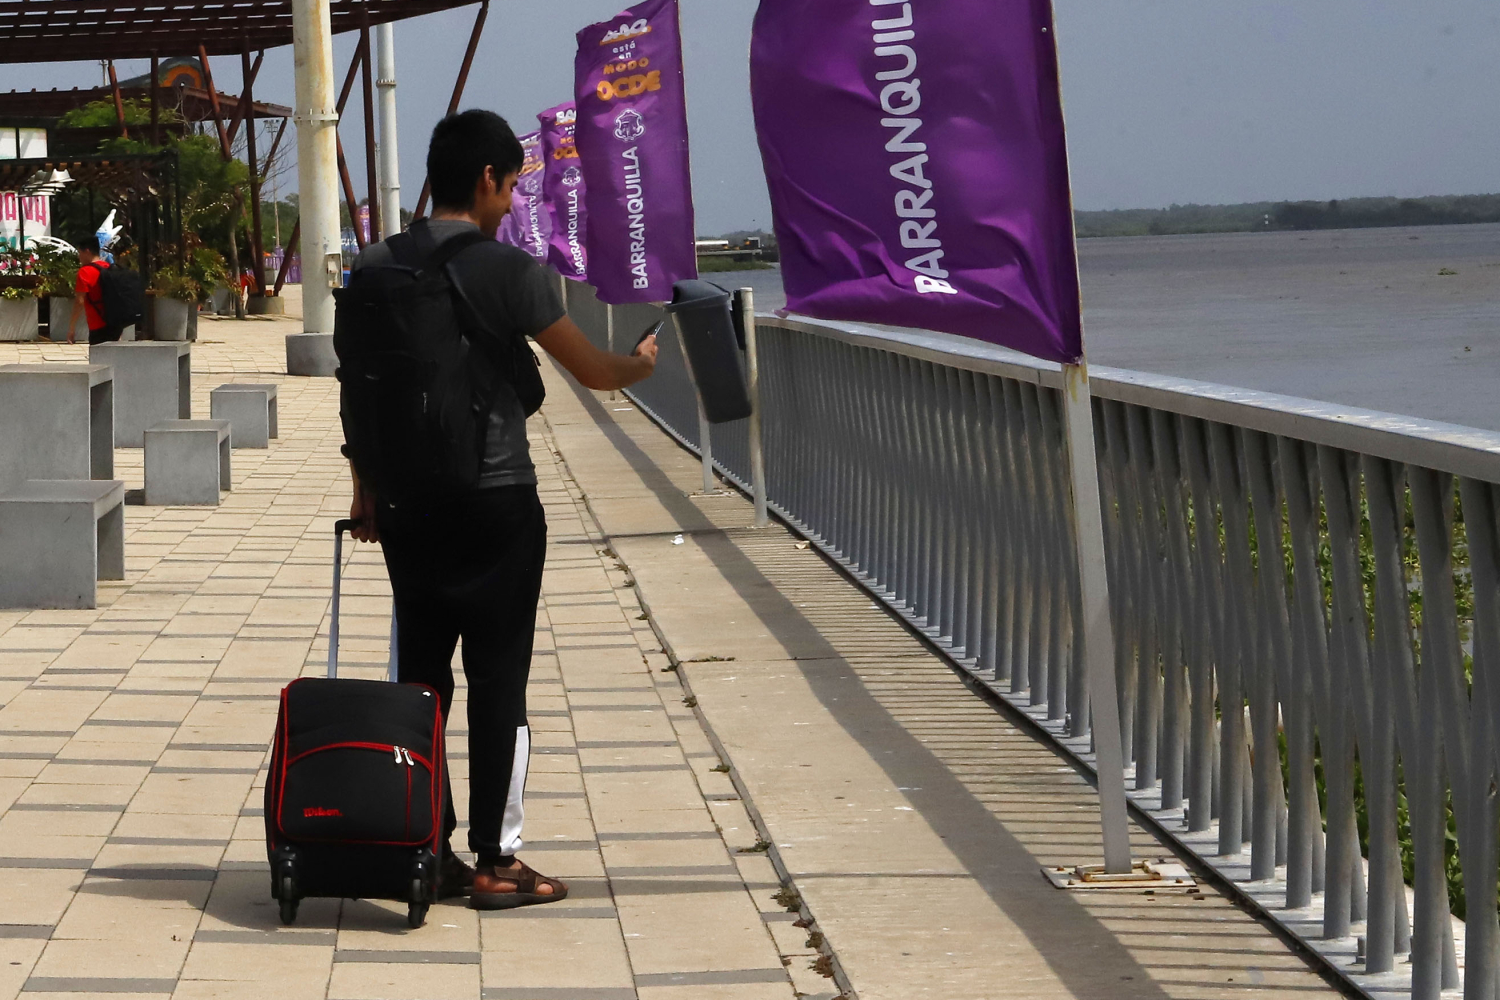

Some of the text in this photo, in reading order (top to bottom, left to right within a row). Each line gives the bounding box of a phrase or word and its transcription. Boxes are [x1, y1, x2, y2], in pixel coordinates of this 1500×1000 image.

[612, 40, 636, 54] está
[603, 57, 649, 75] MODO
[596, 70, 662, 101] OCDE
[567, 188, 586, 275] BARRANQUILLA
[622, 146, 648, 291] BARRANQUILLA
